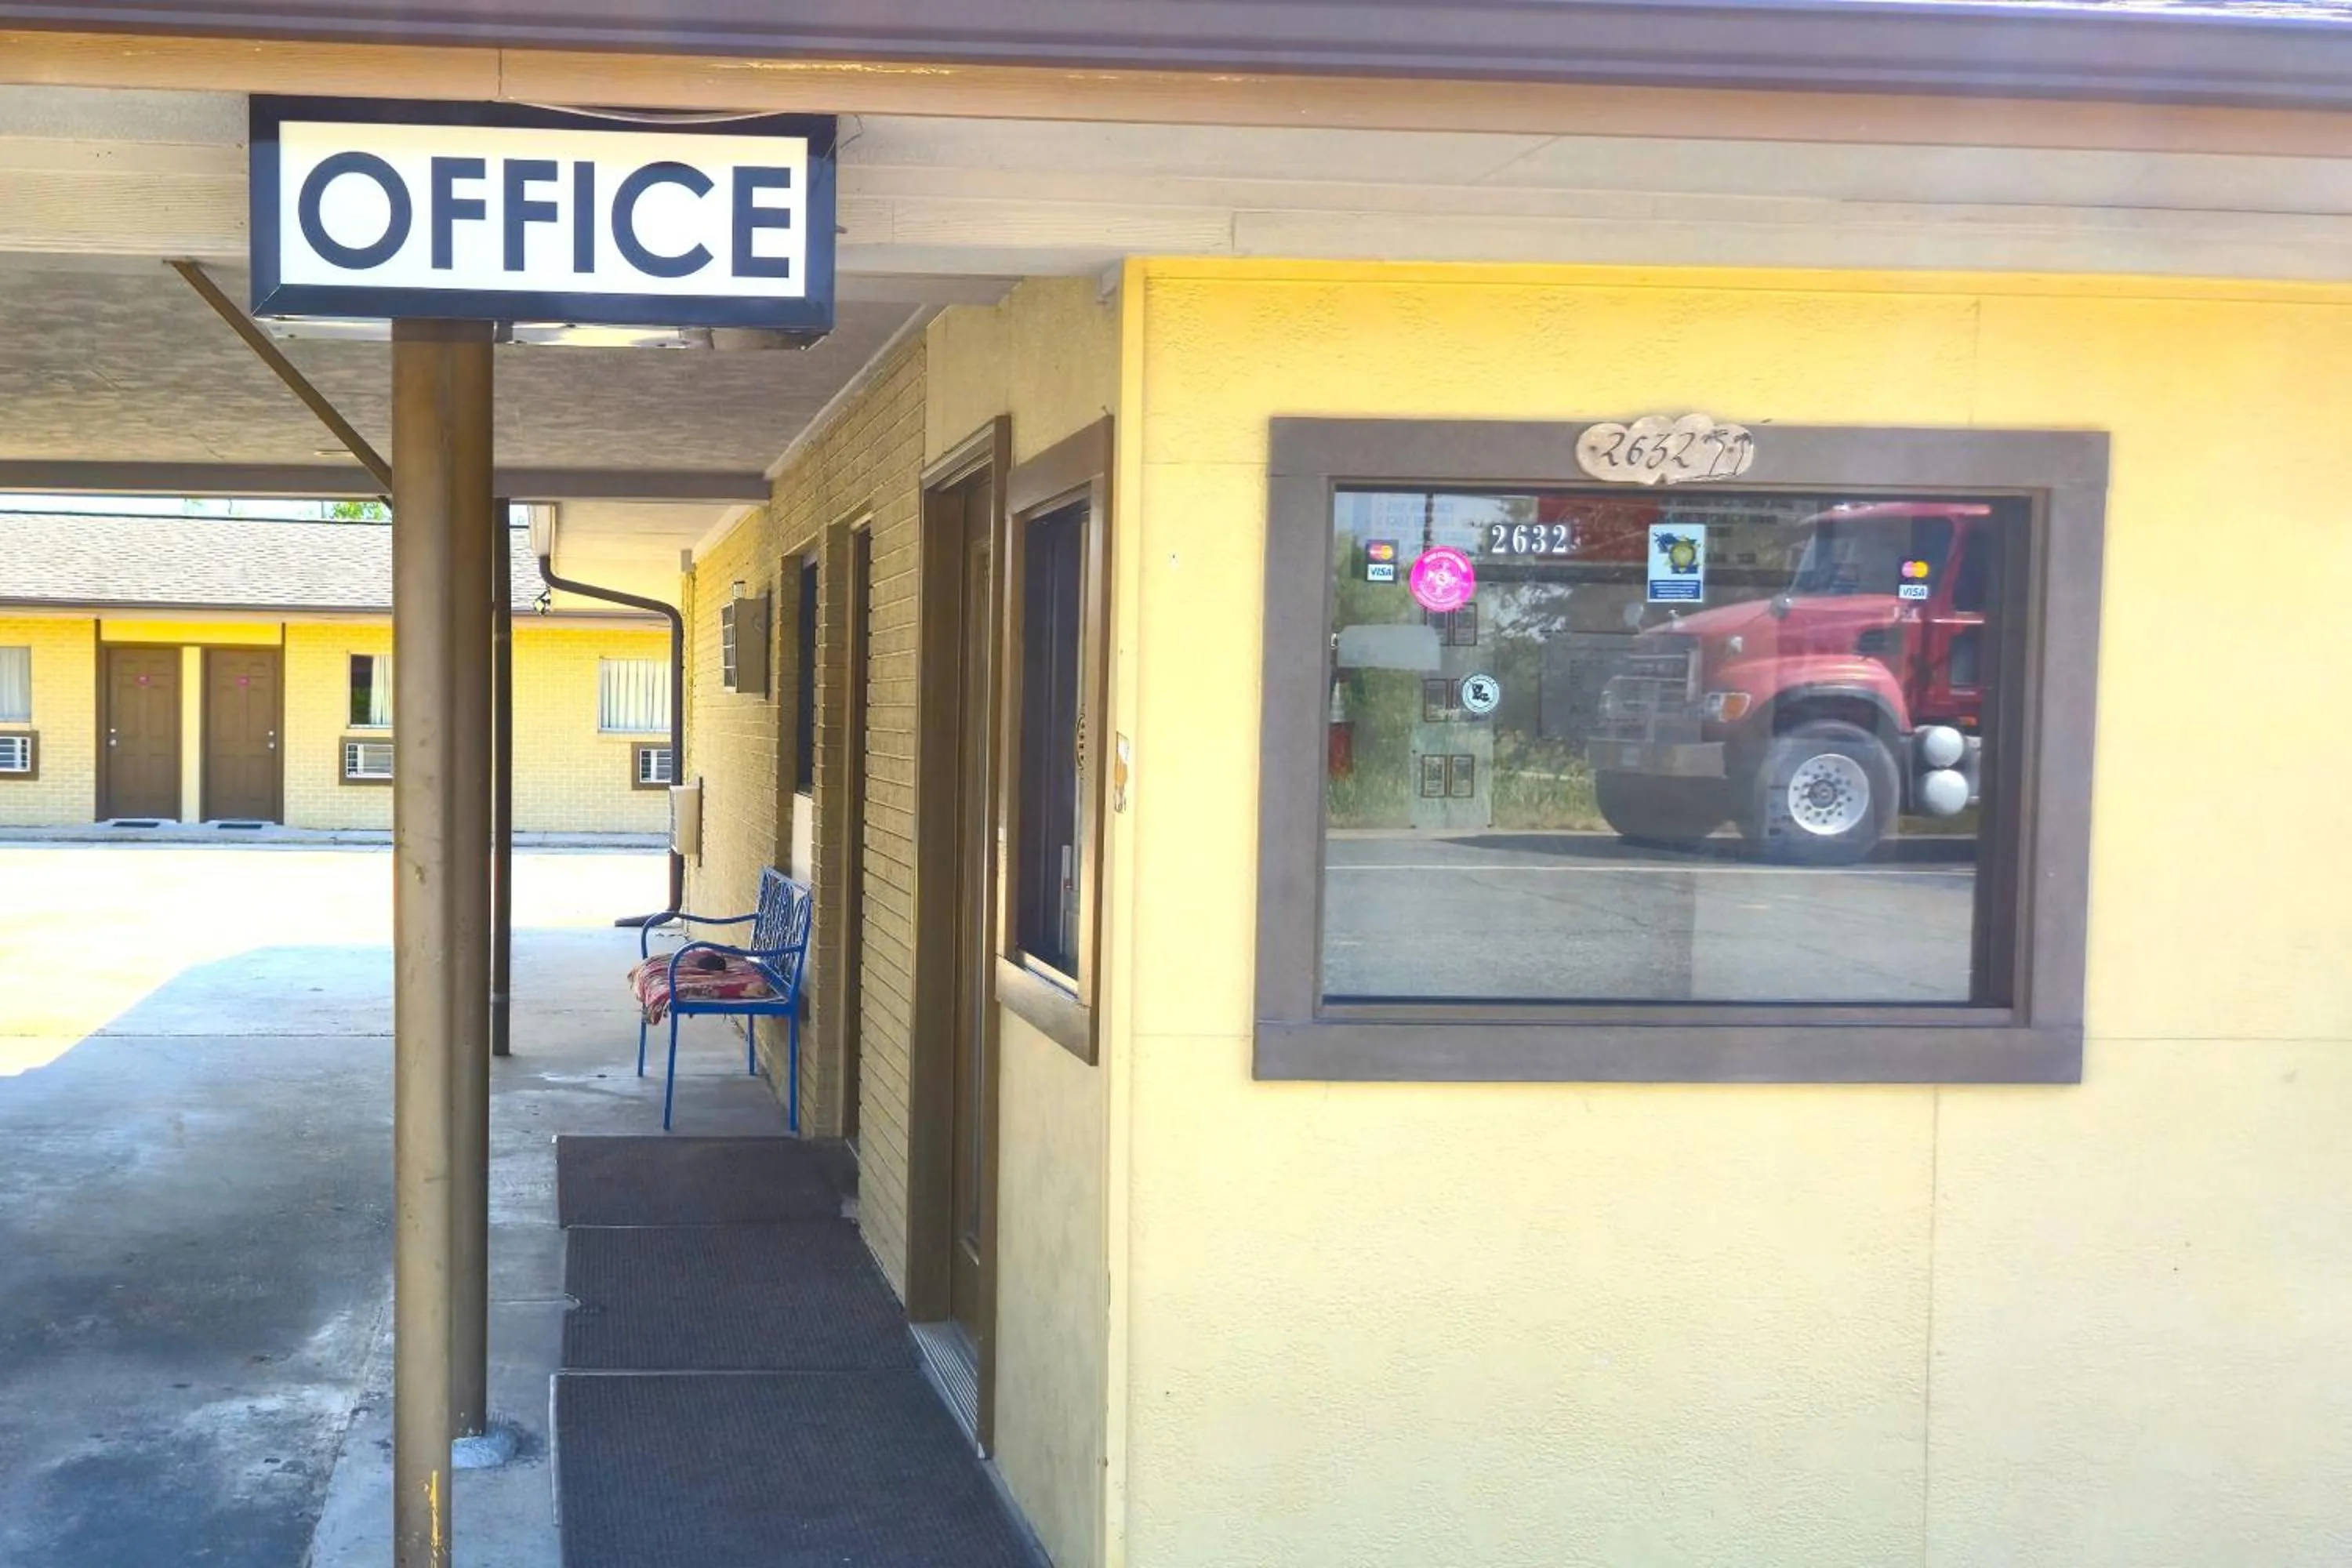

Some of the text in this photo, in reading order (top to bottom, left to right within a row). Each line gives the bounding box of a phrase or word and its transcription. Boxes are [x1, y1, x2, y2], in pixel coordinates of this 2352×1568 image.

[298, 151, 791, 278] OFFICE
[1600, 432, 1696, 470] 2632
[1491, 524, 1567, 554] 2632
[1370, 566, 1392, 576] VISA
[1902, 588, 1926, 597] VISA
